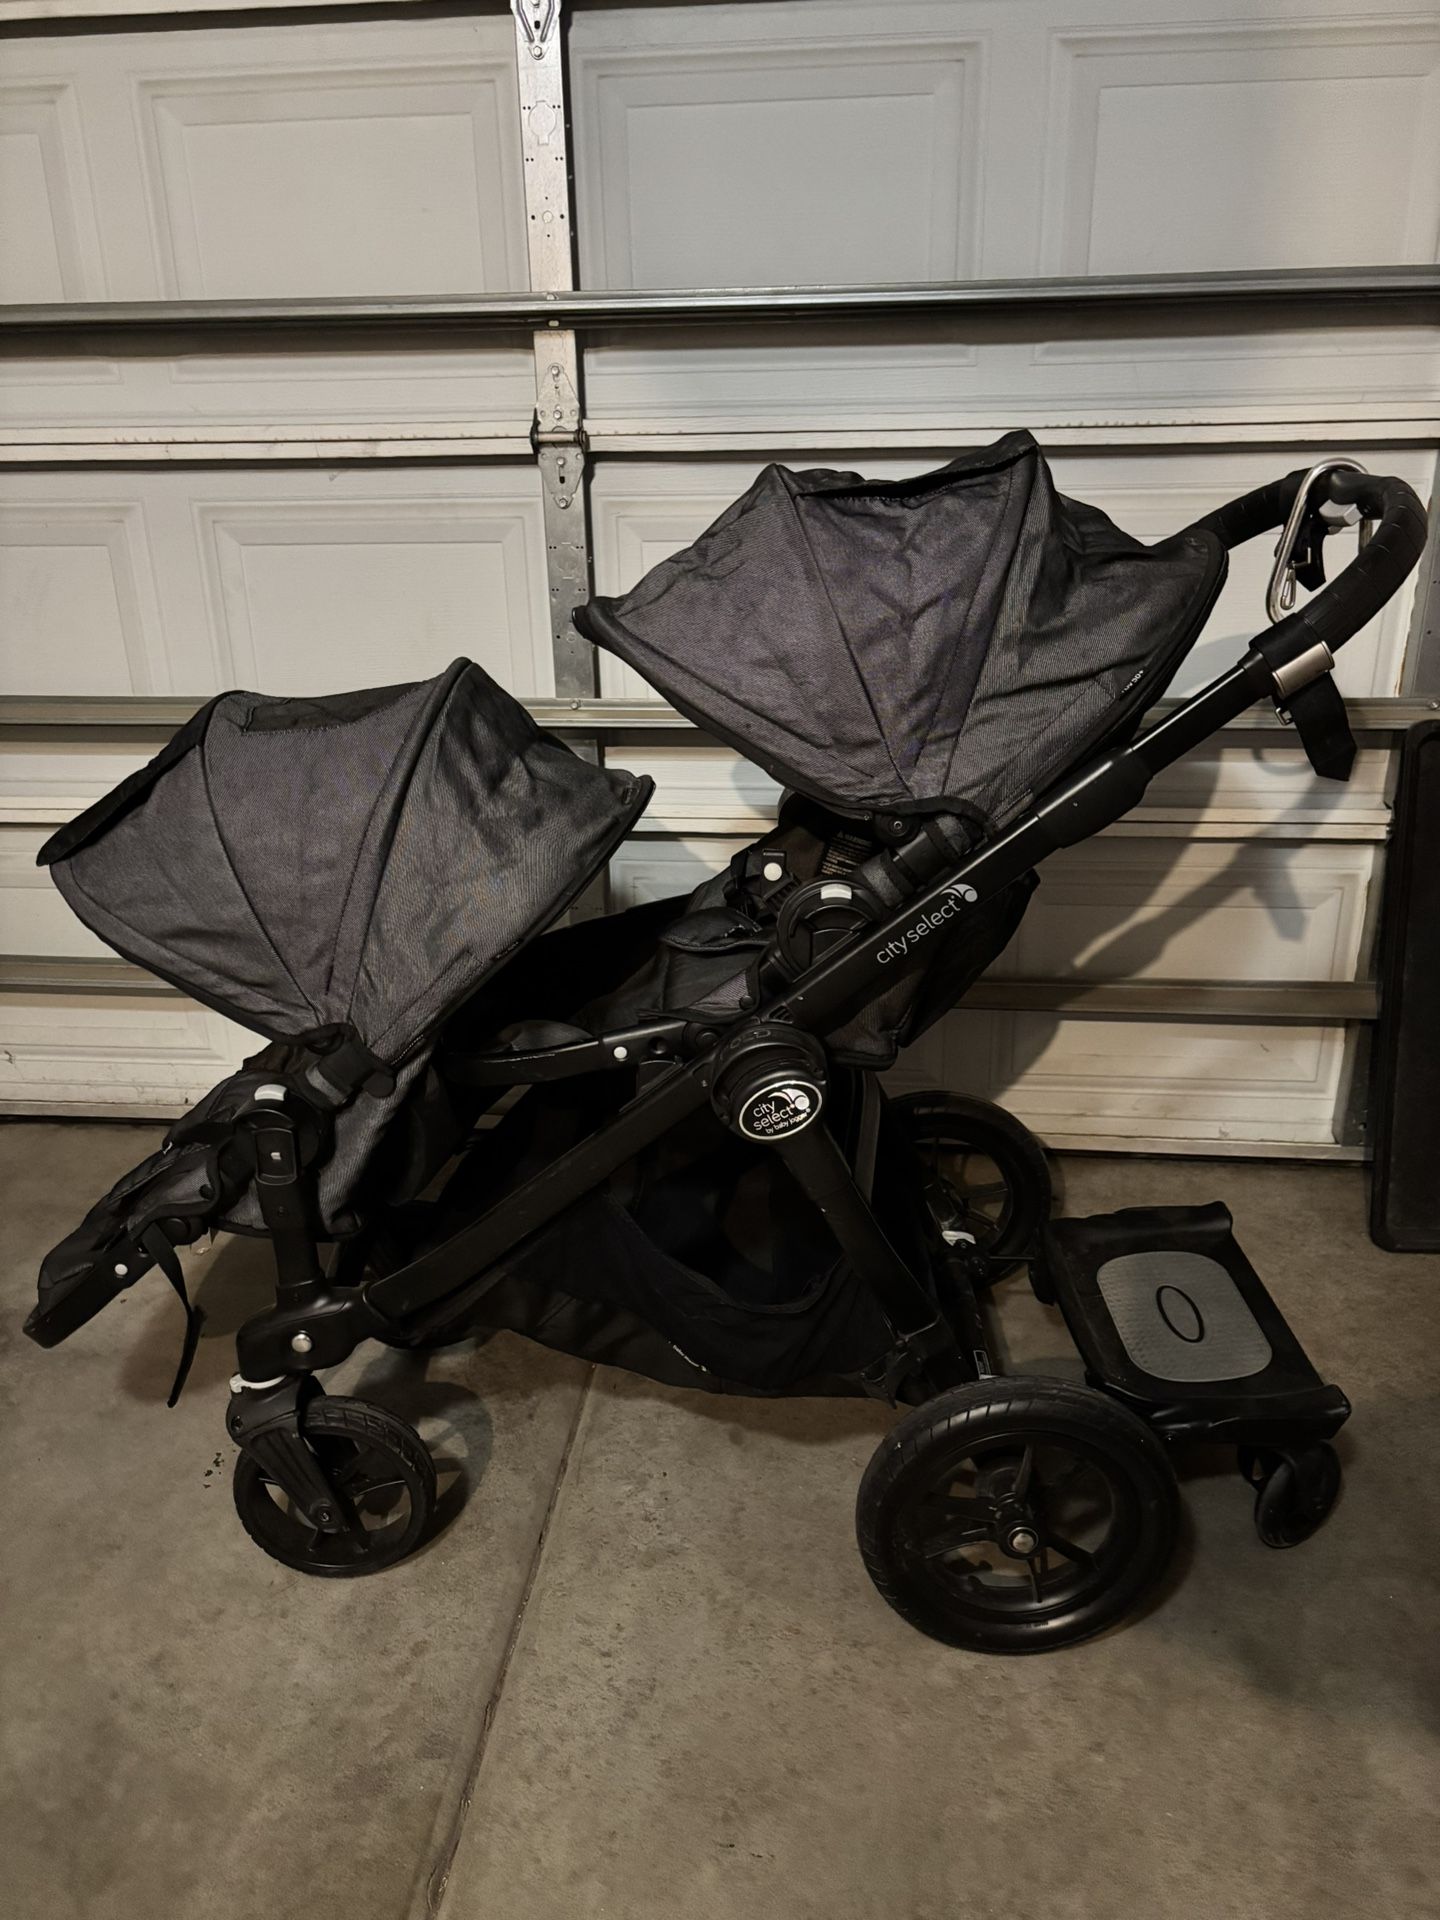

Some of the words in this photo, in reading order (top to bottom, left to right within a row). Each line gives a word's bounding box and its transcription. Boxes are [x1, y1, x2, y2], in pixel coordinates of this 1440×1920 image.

[876, 936, 908, 964] city
[906, 898, 961, 943] select
[753, 1100, 776, 1118] city
[753, 1106, 794, 1131] select
[765, 1127, 774, 1135] by
